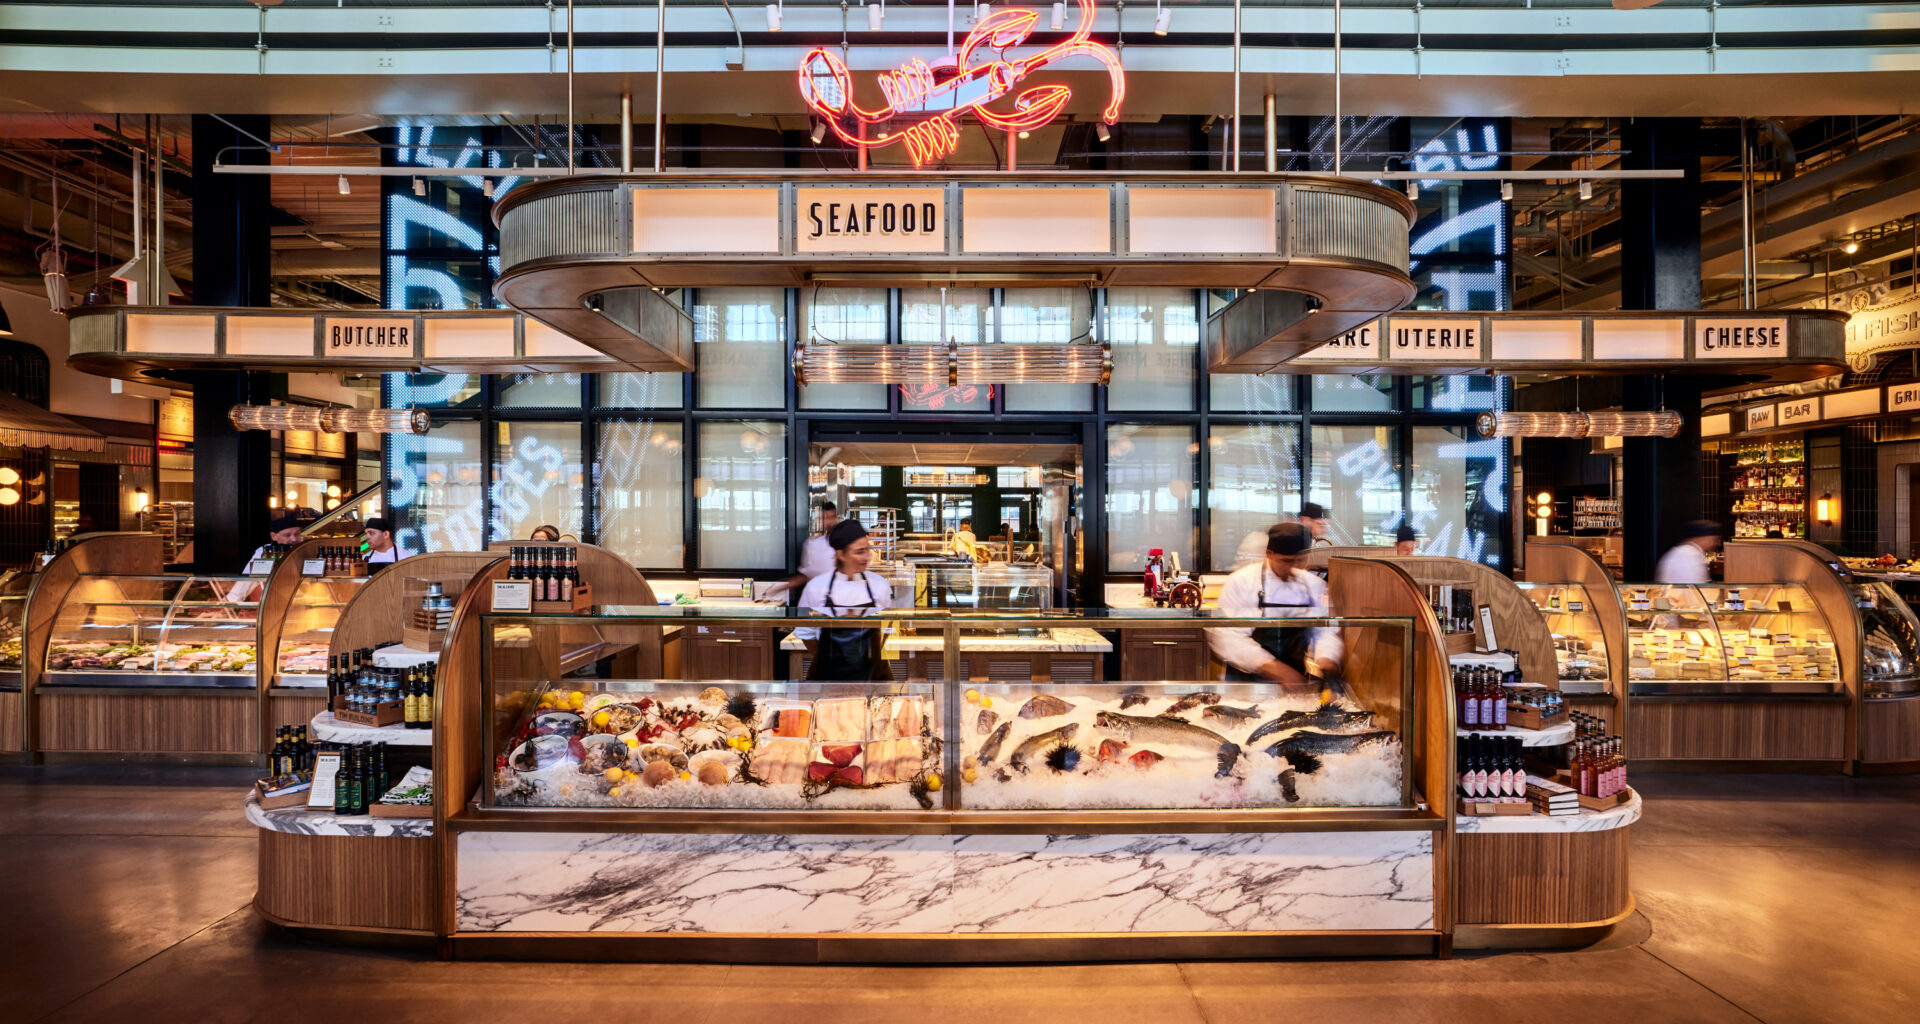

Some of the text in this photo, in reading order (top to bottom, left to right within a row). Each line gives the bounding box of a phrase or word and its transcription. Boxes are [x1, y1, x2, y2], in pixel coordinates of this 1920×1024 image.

[808, 202, 937, 239] SEAFOOD
[332, 325, 410, 349] BUTCHER
[1396, 328, 1475, 349] UTERIE
[1703, 326, 1781, 351] CHEESE
[1894, 390, 1920, 405] GRI
[1751, 404, 1811, 424] RAW BAR
